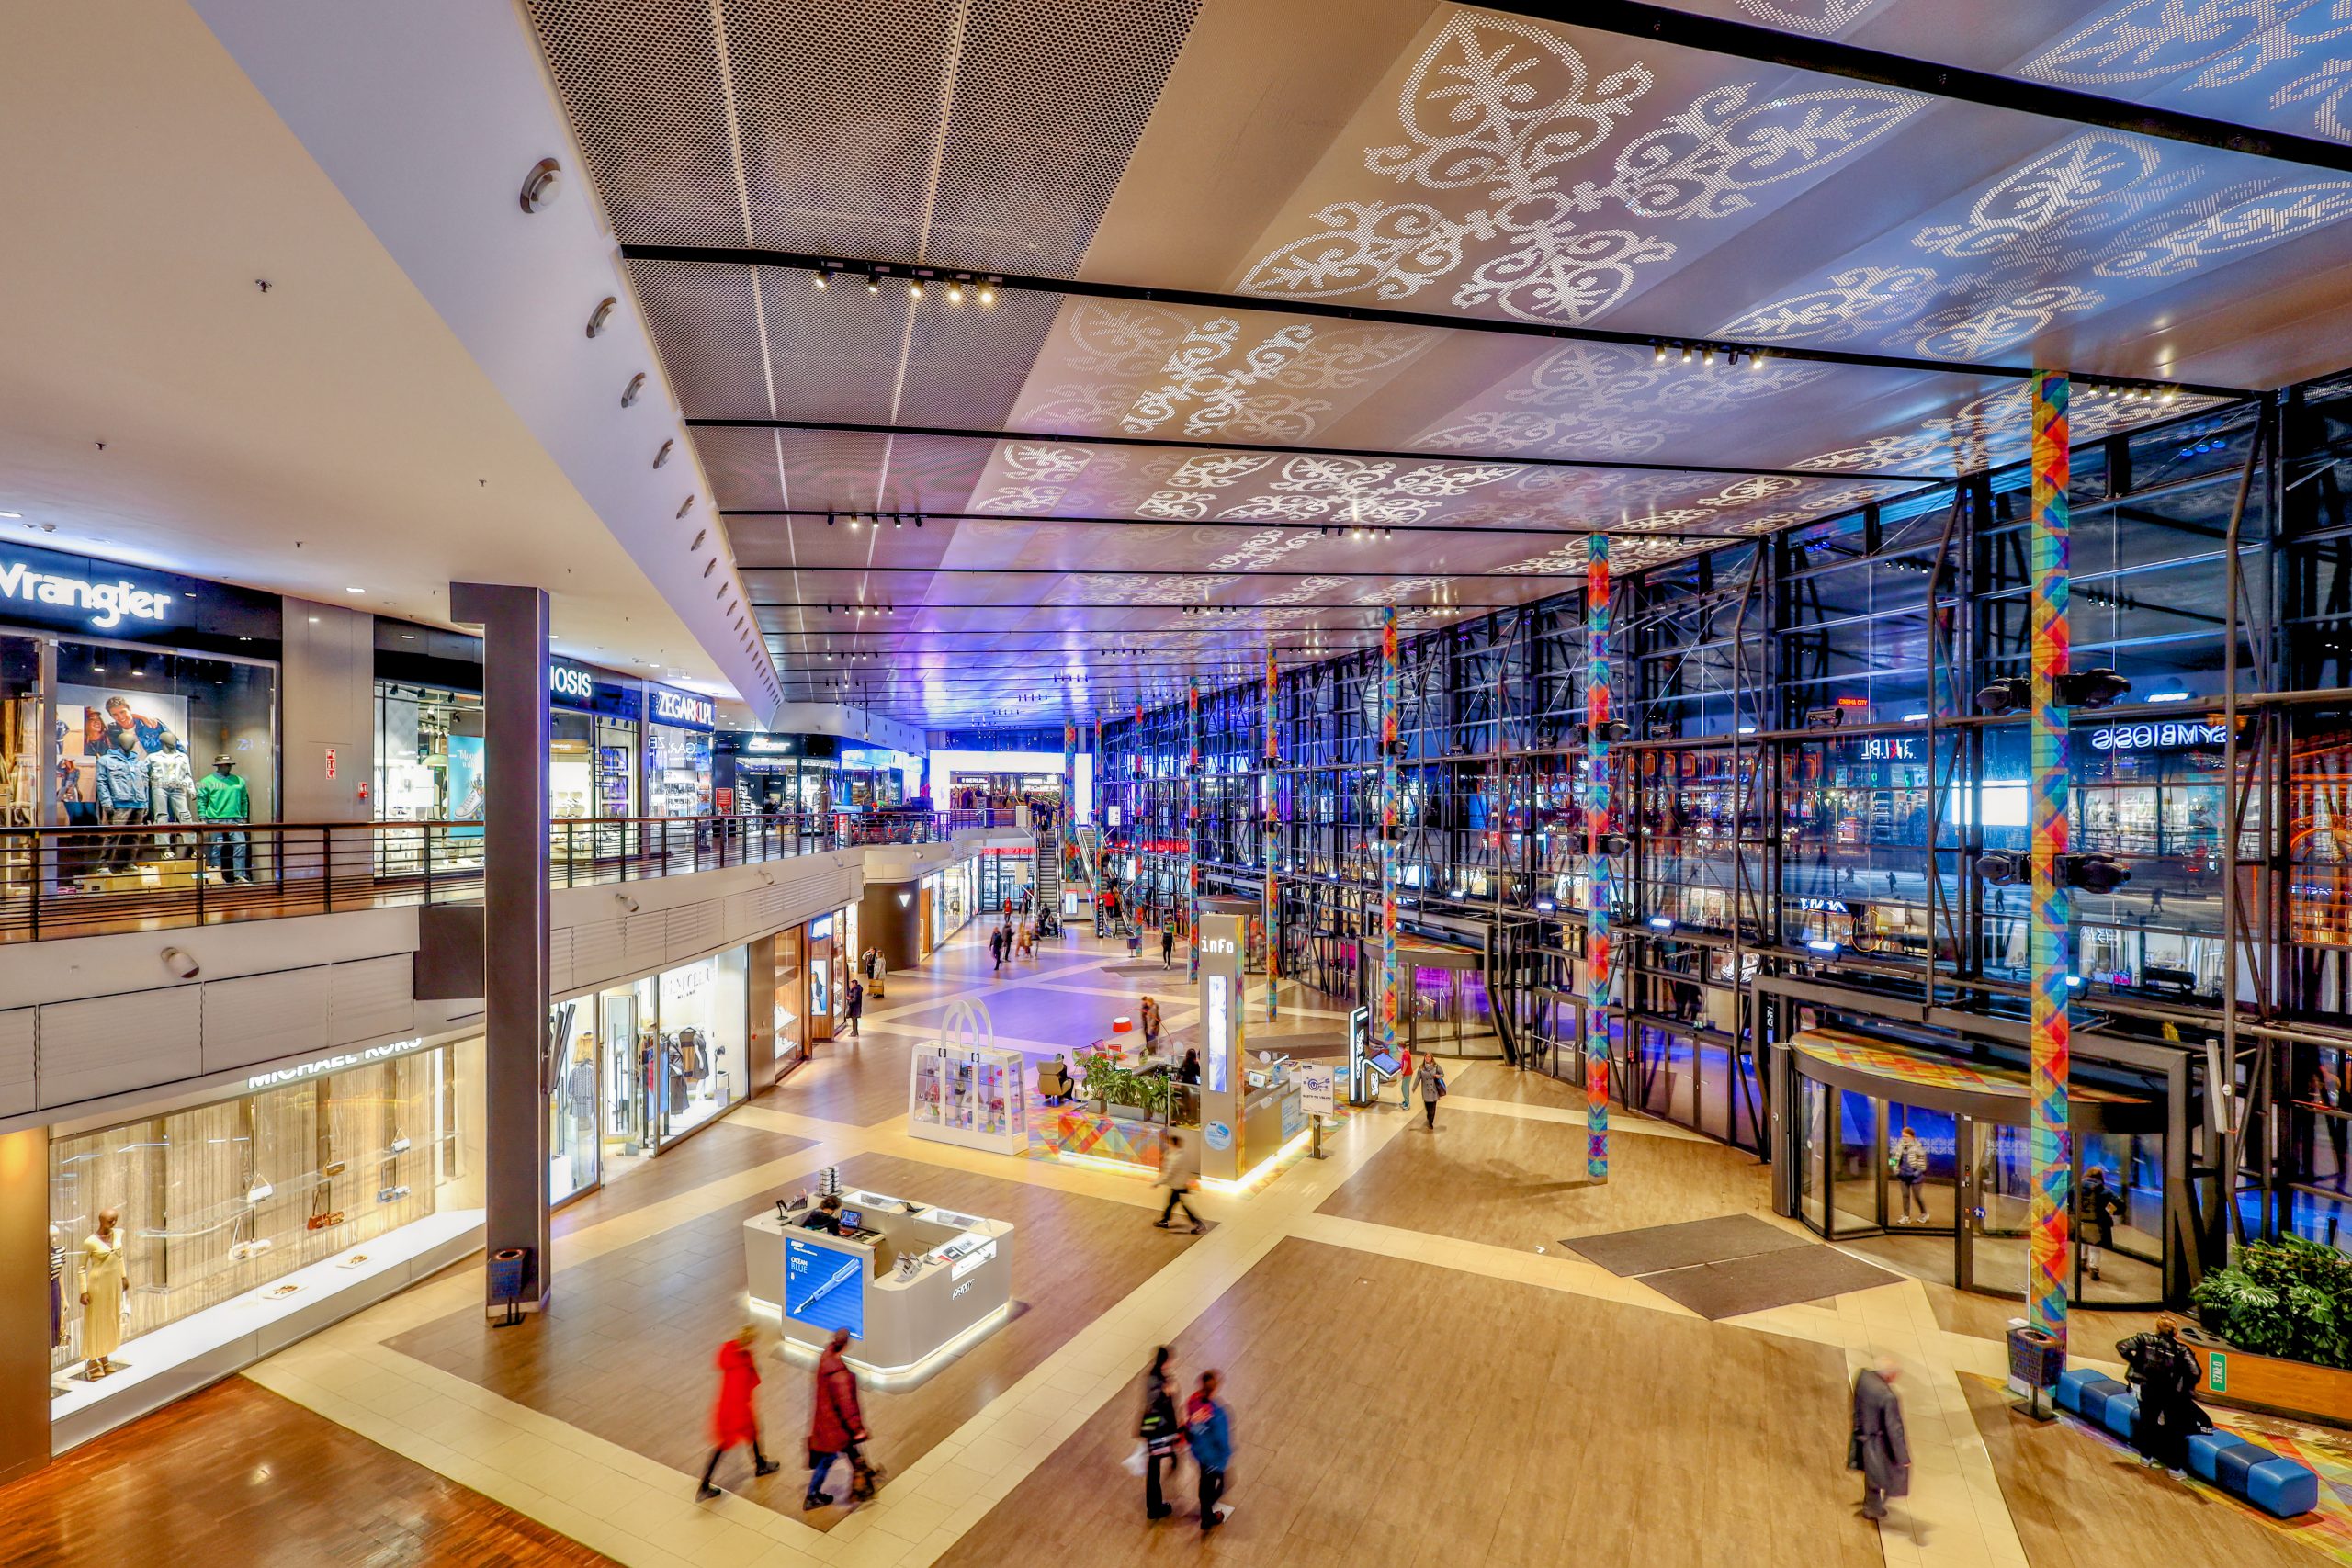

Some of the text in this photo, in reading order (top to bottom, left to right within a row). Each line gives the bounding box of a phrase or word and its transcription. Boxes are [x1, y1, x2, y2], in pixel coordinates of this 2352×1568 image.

[1201, 935, 1234, 954] info
[790, 1256, 808, 1266] OCEAN
[790, 1262, 808, 1274] BLUE
